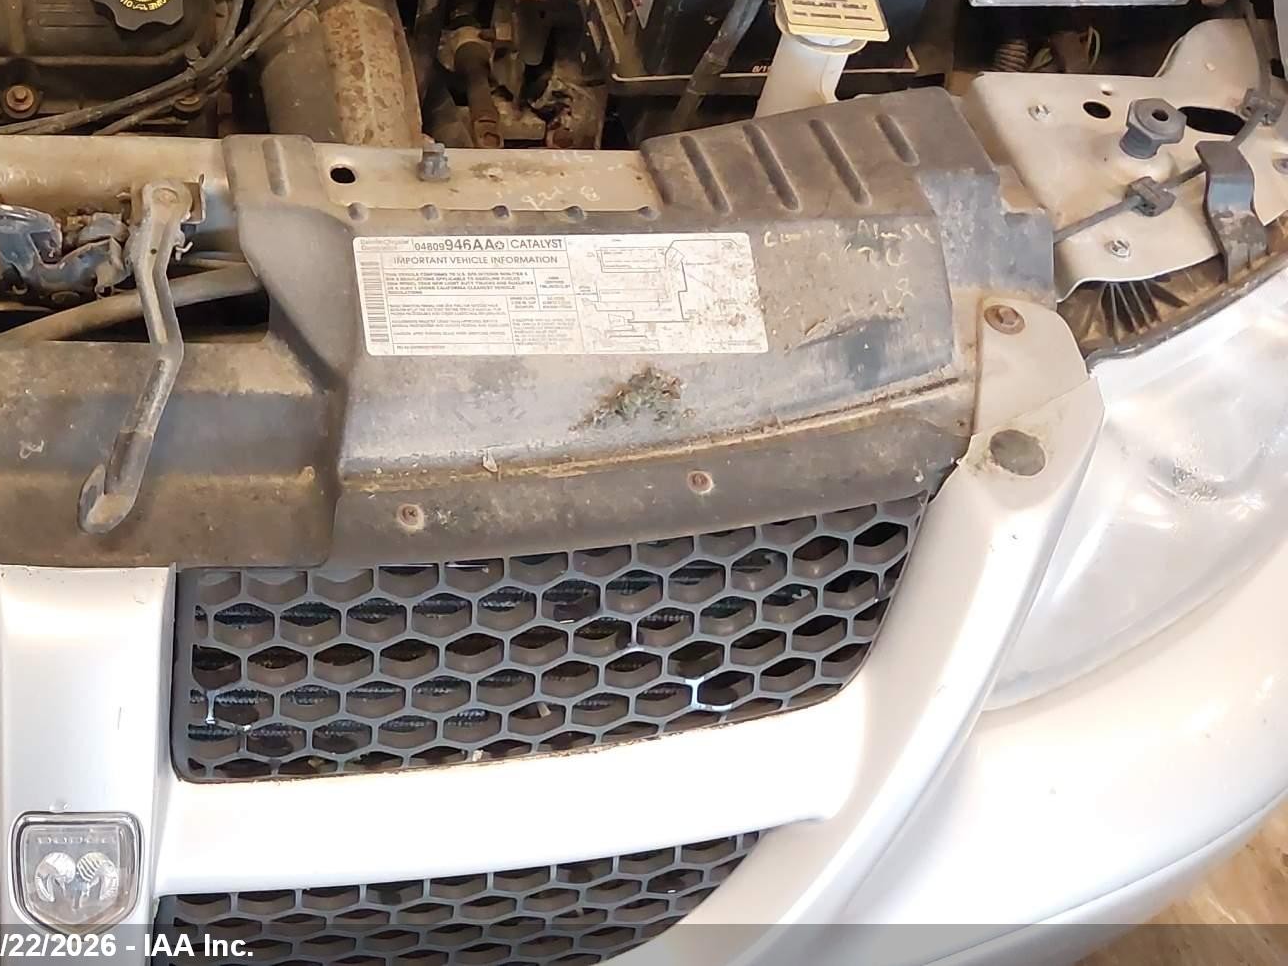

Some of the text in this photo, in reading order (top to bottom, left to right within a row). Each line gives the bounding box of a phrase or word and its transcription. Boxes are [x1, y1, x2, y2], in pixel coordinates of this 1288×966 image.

[510, 239, 562, 249] CATALYST
[450, 256, 488, 264] VEHICLE
[491, 256, 558, 264] INFORMATION
